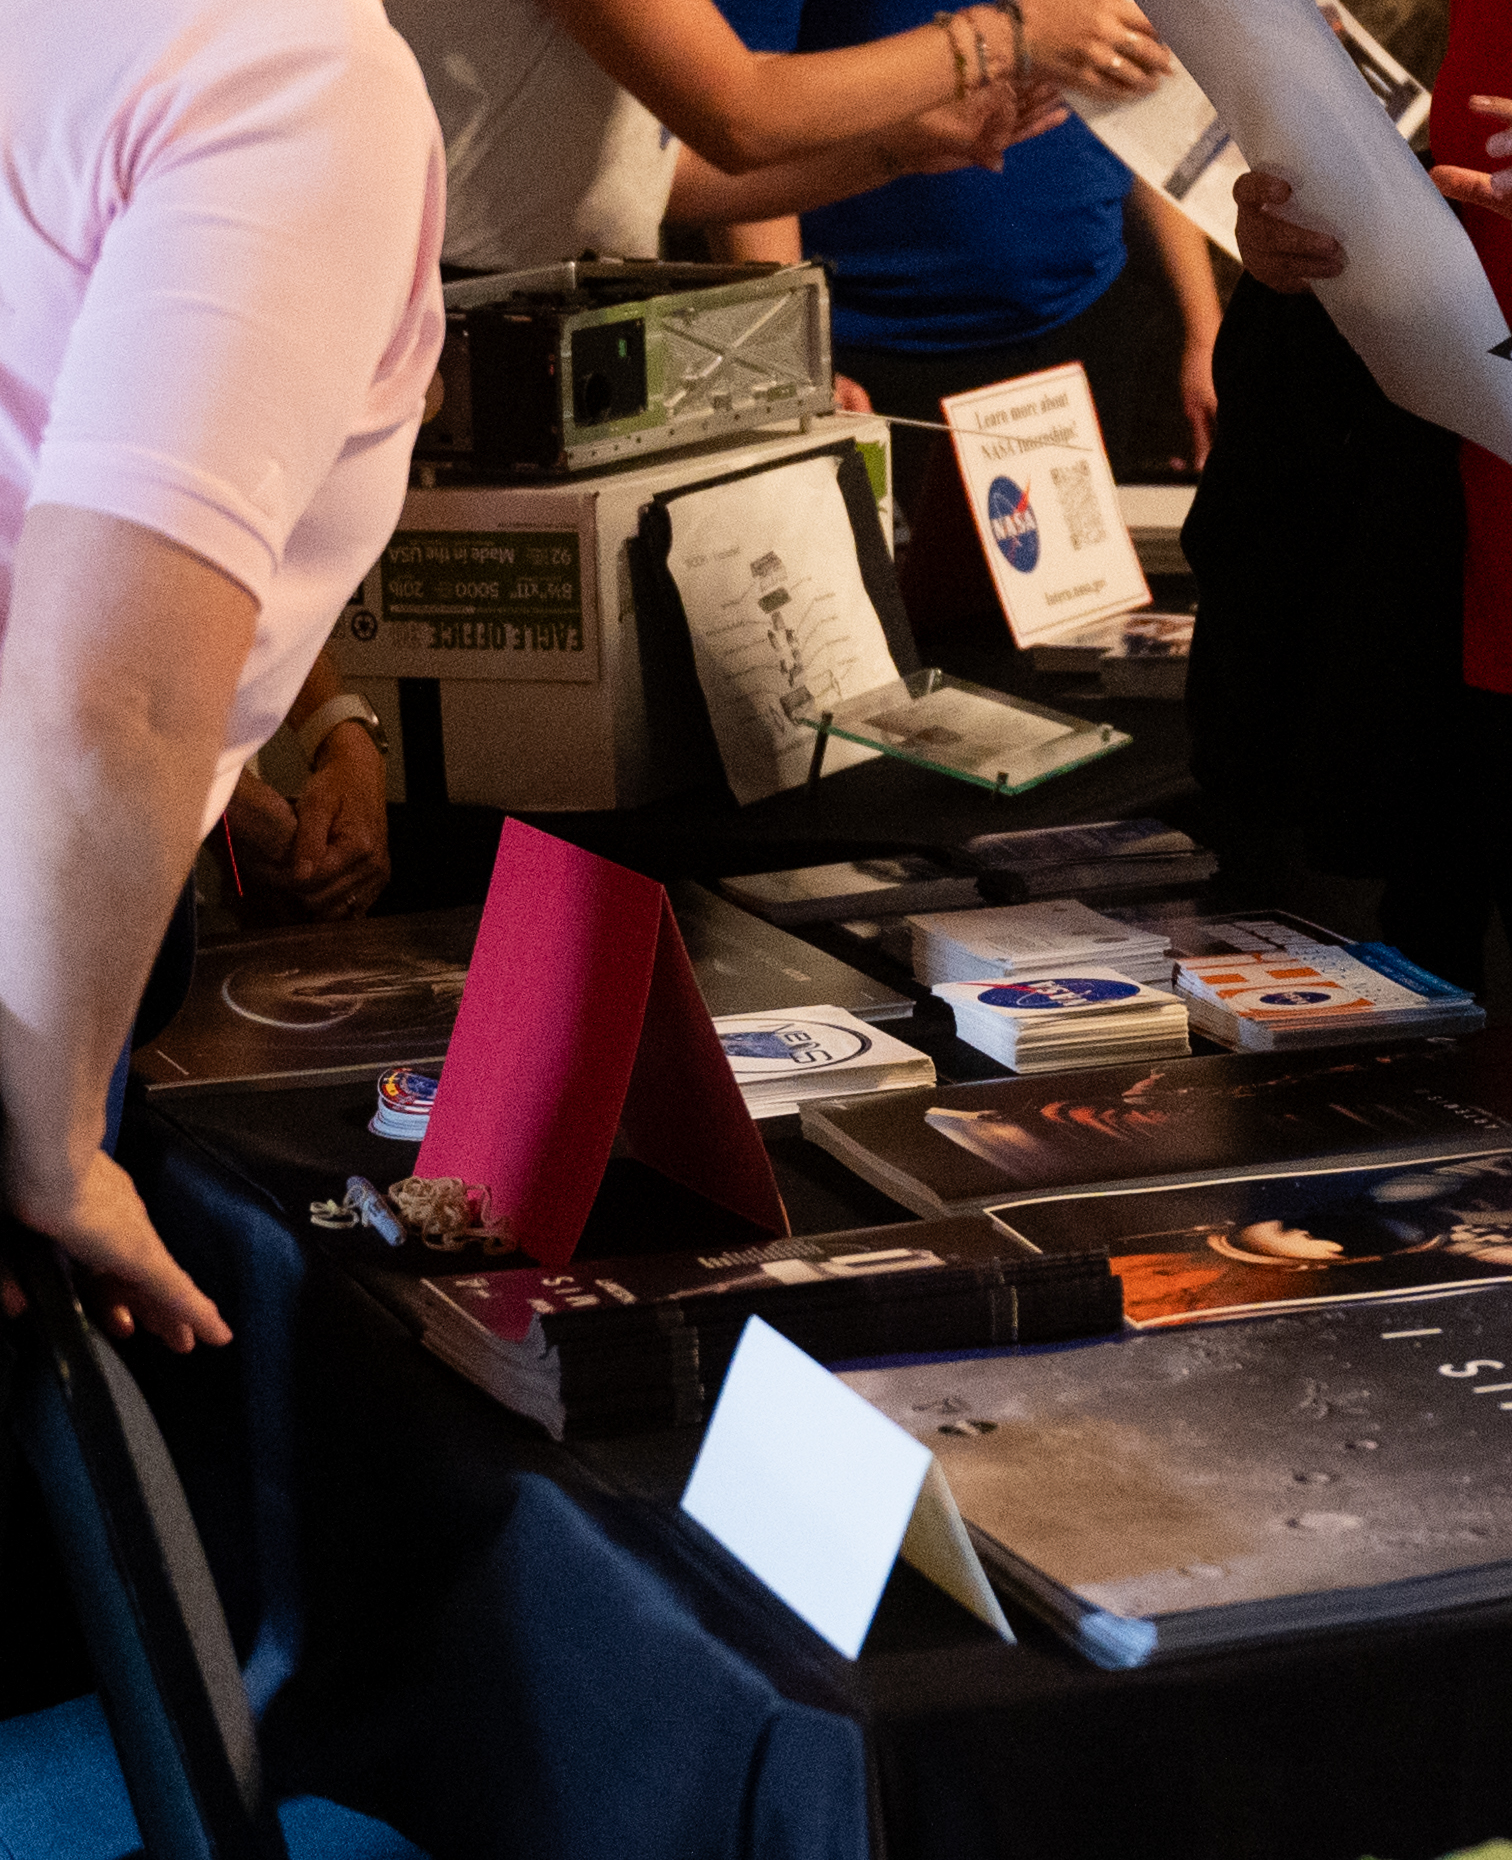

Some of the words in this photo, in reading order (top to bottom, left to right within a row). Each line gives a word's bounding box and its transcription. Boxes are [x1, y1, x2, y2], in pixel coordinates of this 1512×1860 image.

[991, 509, 1038, 542] NASA
[387, 547, 423, 564] USA
[425, 548, 450, 564] the
[452, 548, 468, 564] in
[469, 547, 516, 564] Made
[454, 581, 500, 598] 5000
[426, 620, 506, 650] OFFICE
[513, 621, 584, 652] EAGLE
